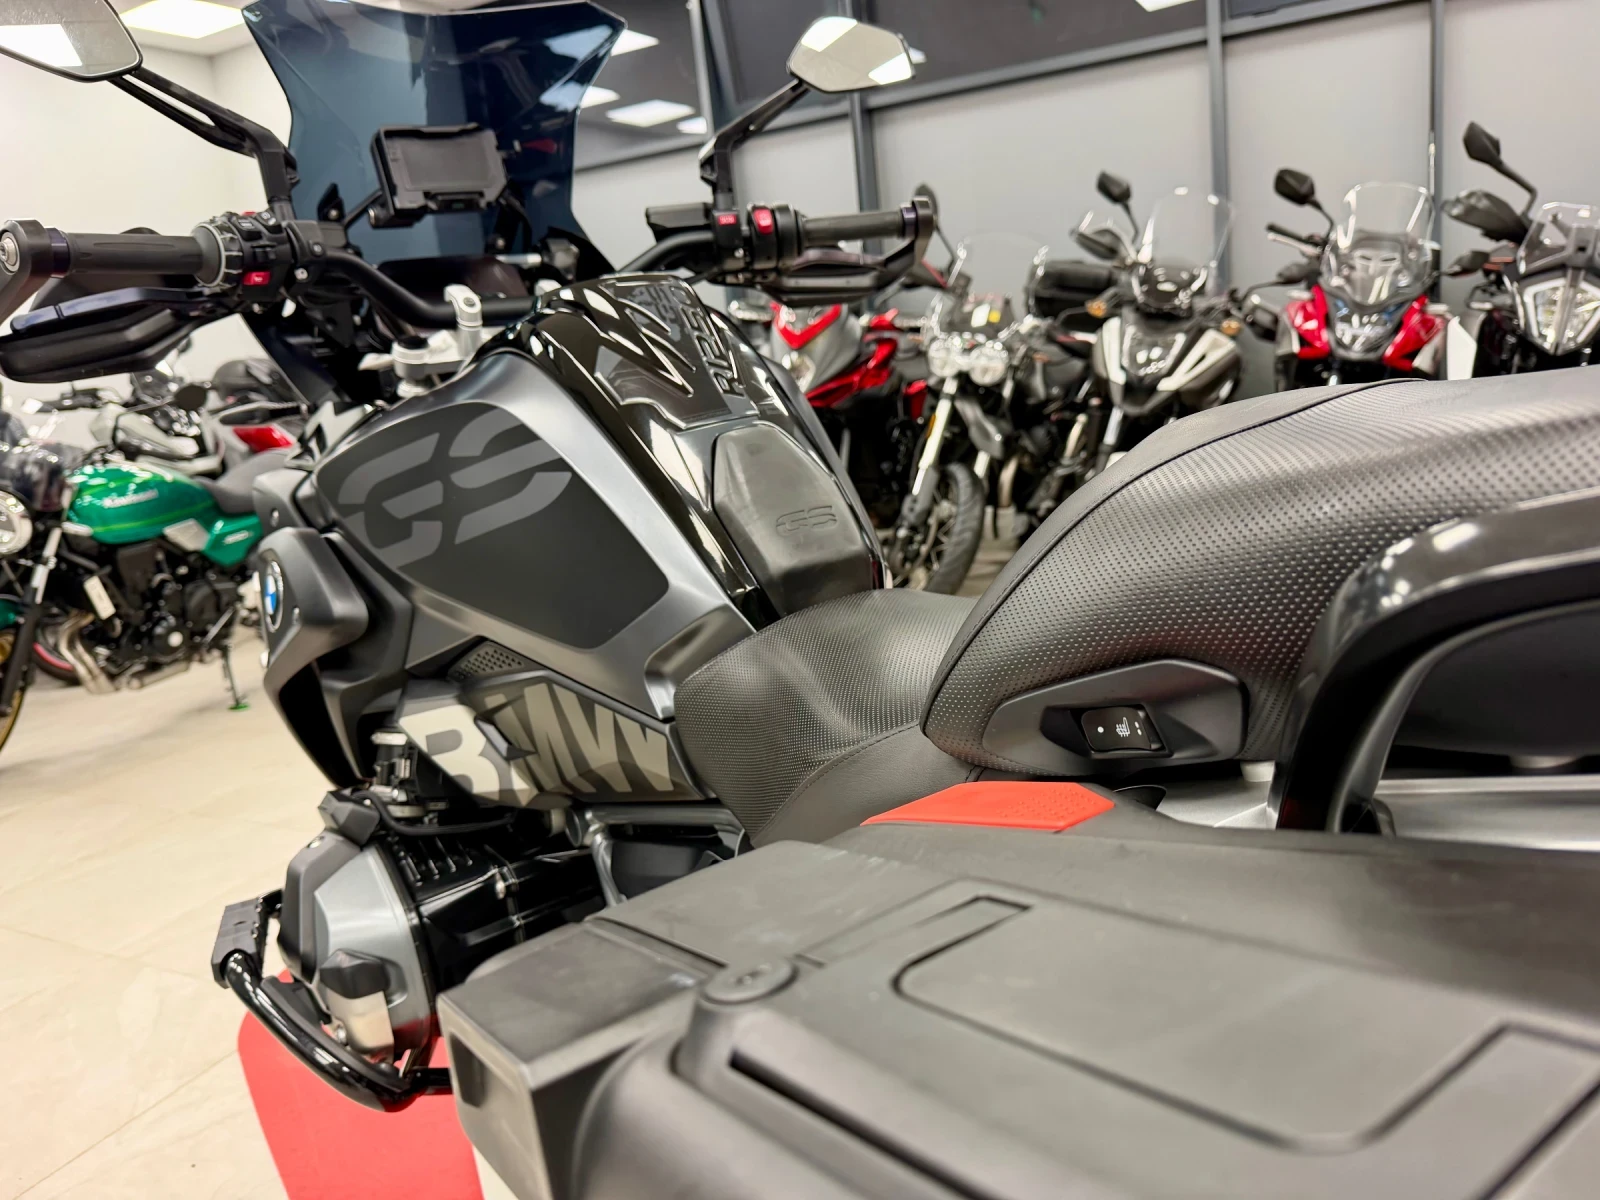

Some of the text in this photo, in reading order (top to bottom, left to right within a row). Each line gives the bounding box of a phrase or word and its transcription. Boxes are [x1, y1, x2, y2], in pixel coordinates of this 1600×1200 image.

[338, 408, 572, 568] GS
[775, 505, 839, 537] GS
[399, 683, 675, 806] BMW
